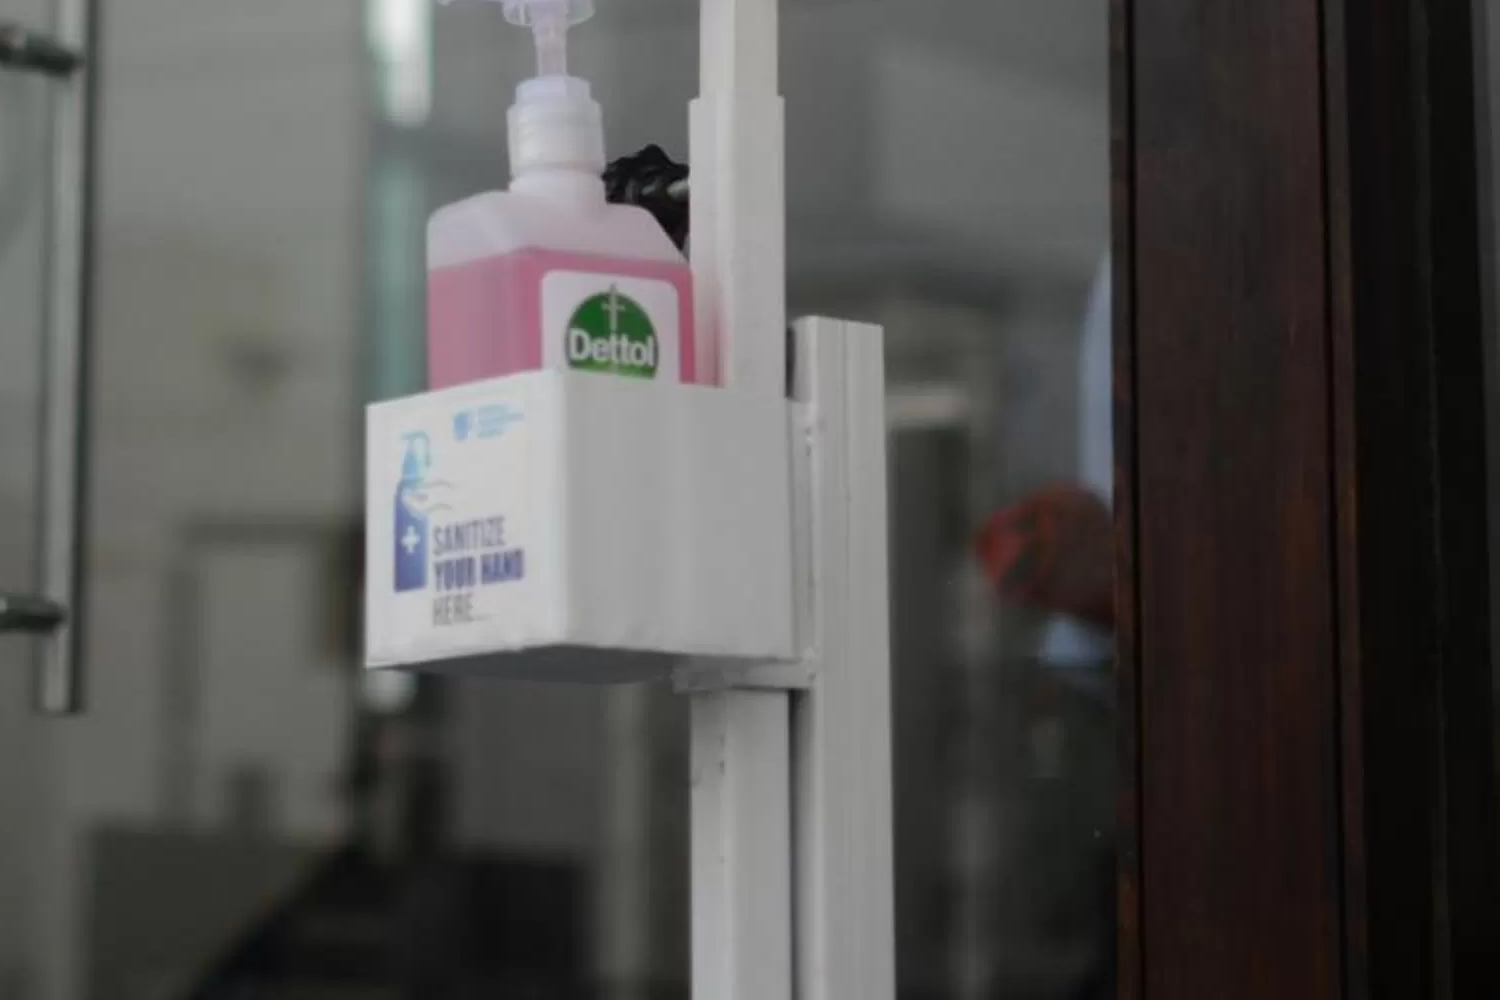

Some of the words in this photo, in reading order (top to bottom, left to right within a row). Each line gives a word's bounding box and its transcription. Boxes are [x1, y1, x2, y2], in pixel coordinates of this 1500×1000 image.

[569, 328, 654, 366] Dettol
[433, 516, 505, 555] SANITIZE
[434, 556, 476, 592] YOUR
[481, 548, 525, 585] HAND
